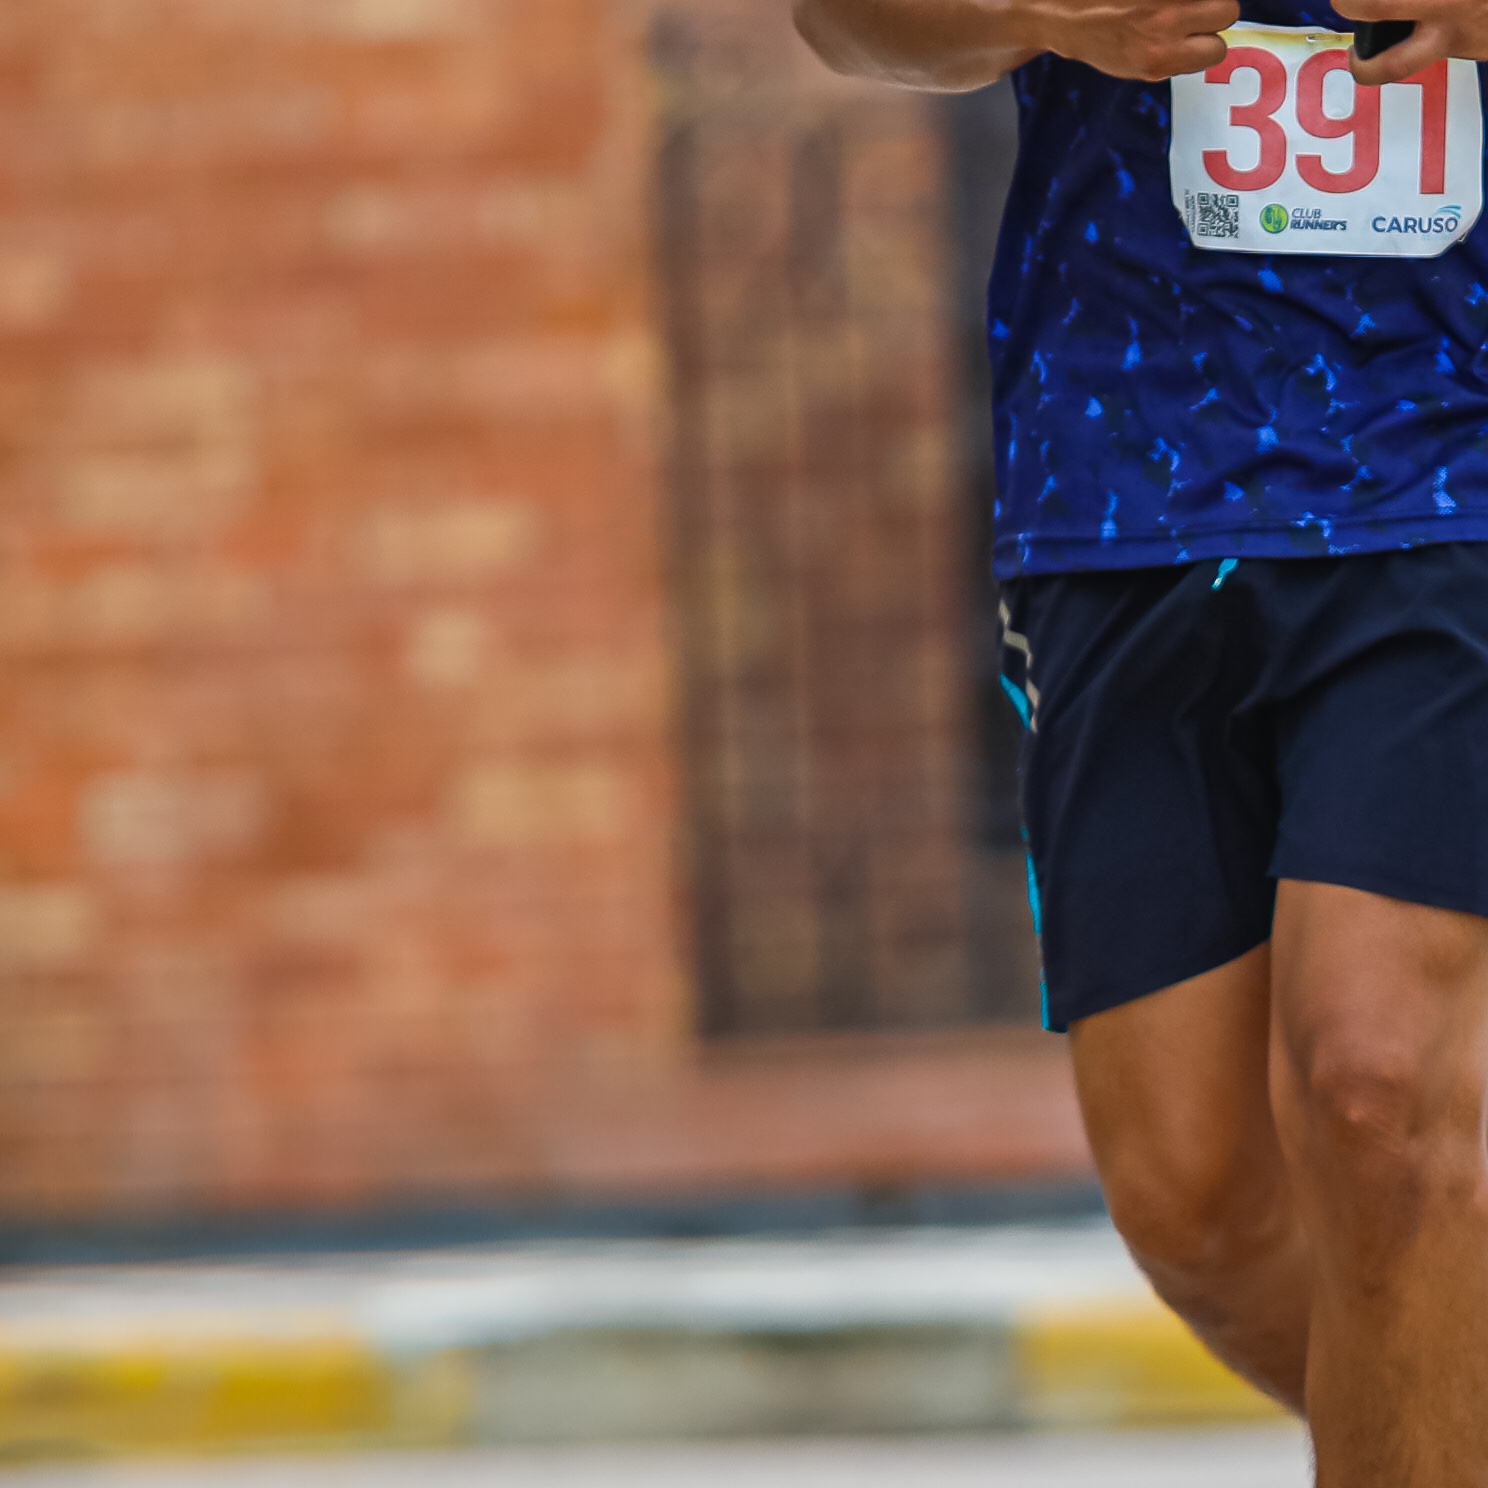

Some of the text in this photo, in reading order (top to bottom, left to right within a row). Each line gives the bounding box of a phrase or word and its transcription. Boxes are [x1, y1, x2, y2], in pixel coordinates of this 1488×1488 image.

[1203, 47, 1447, 194] 391
[1291, 207, 1321, 219] CLUB
[1372, 216, 1458, 233] CARUSO
